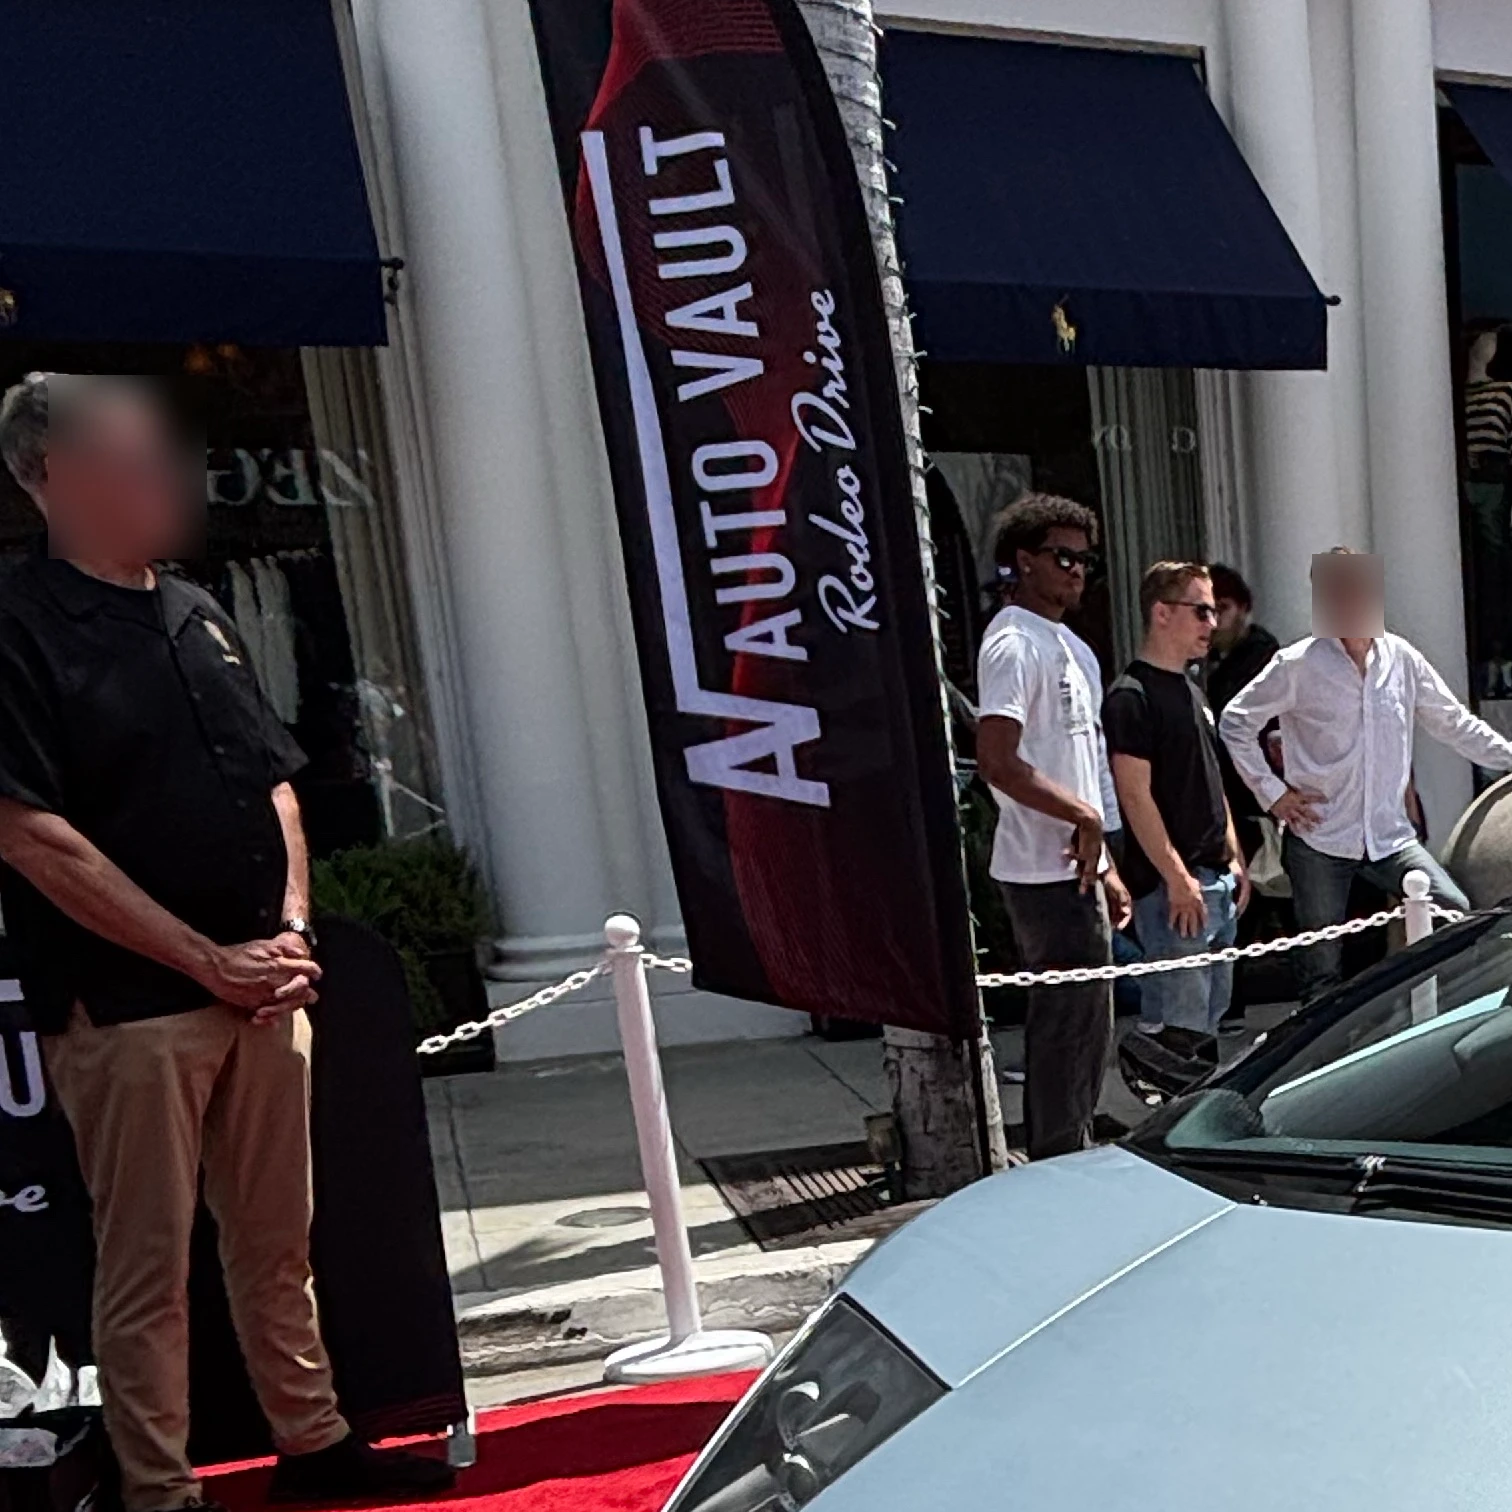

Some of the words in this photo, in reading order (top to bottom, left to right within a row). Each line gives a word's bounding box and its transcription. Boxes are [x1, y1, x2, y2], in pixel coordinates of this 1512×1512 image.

[638, 125, 765, 402] VAULT
[791, 289, 857, 453] Drive
[691, 439, 811, 662] AUTO
[808, 463, 881, 635] Rodeo
